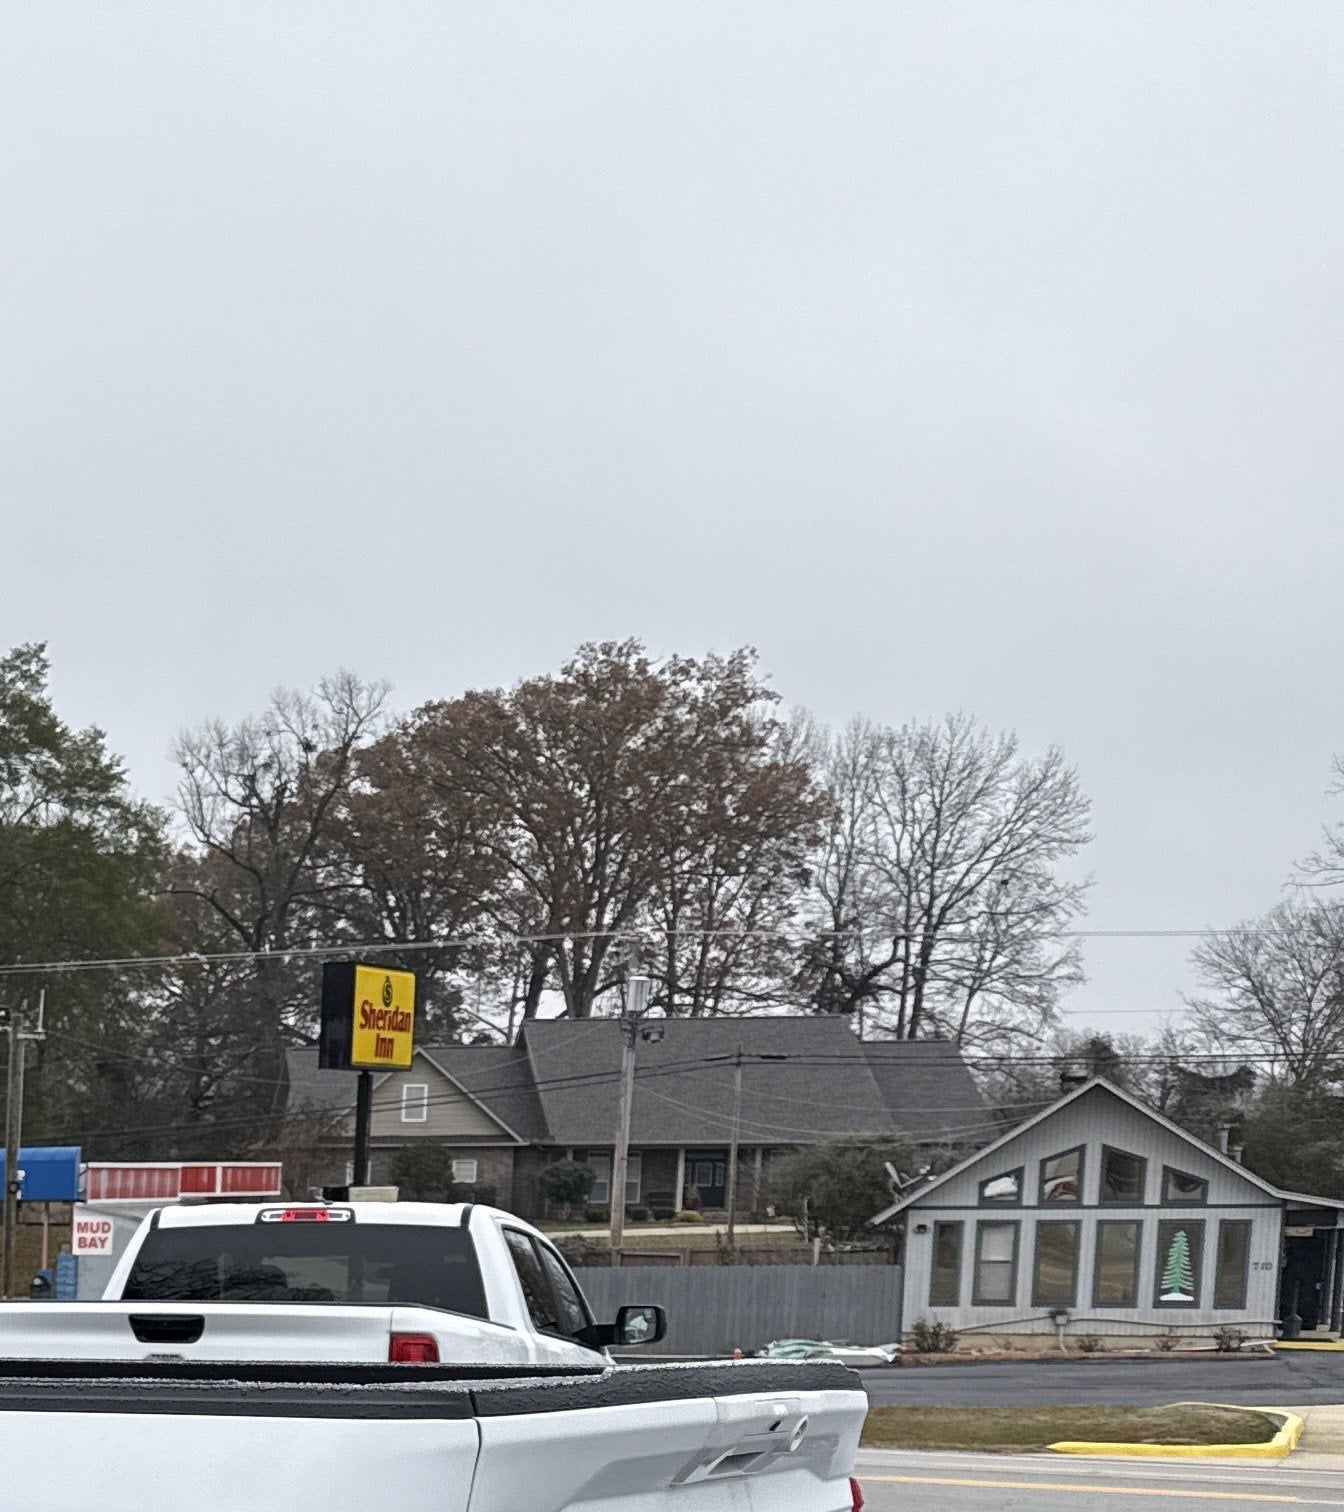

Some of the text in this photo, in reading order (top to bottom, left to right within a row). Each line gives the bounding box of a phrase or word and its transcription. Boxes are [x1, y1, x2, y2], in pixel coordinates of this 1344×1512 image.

[359, 999, 411, 1032] Sheridan
[375, 1033, 394, 1059] Inn
[77, 1221, 111, 1234] MUD
[78, 1237, 108, 1249] BAY
